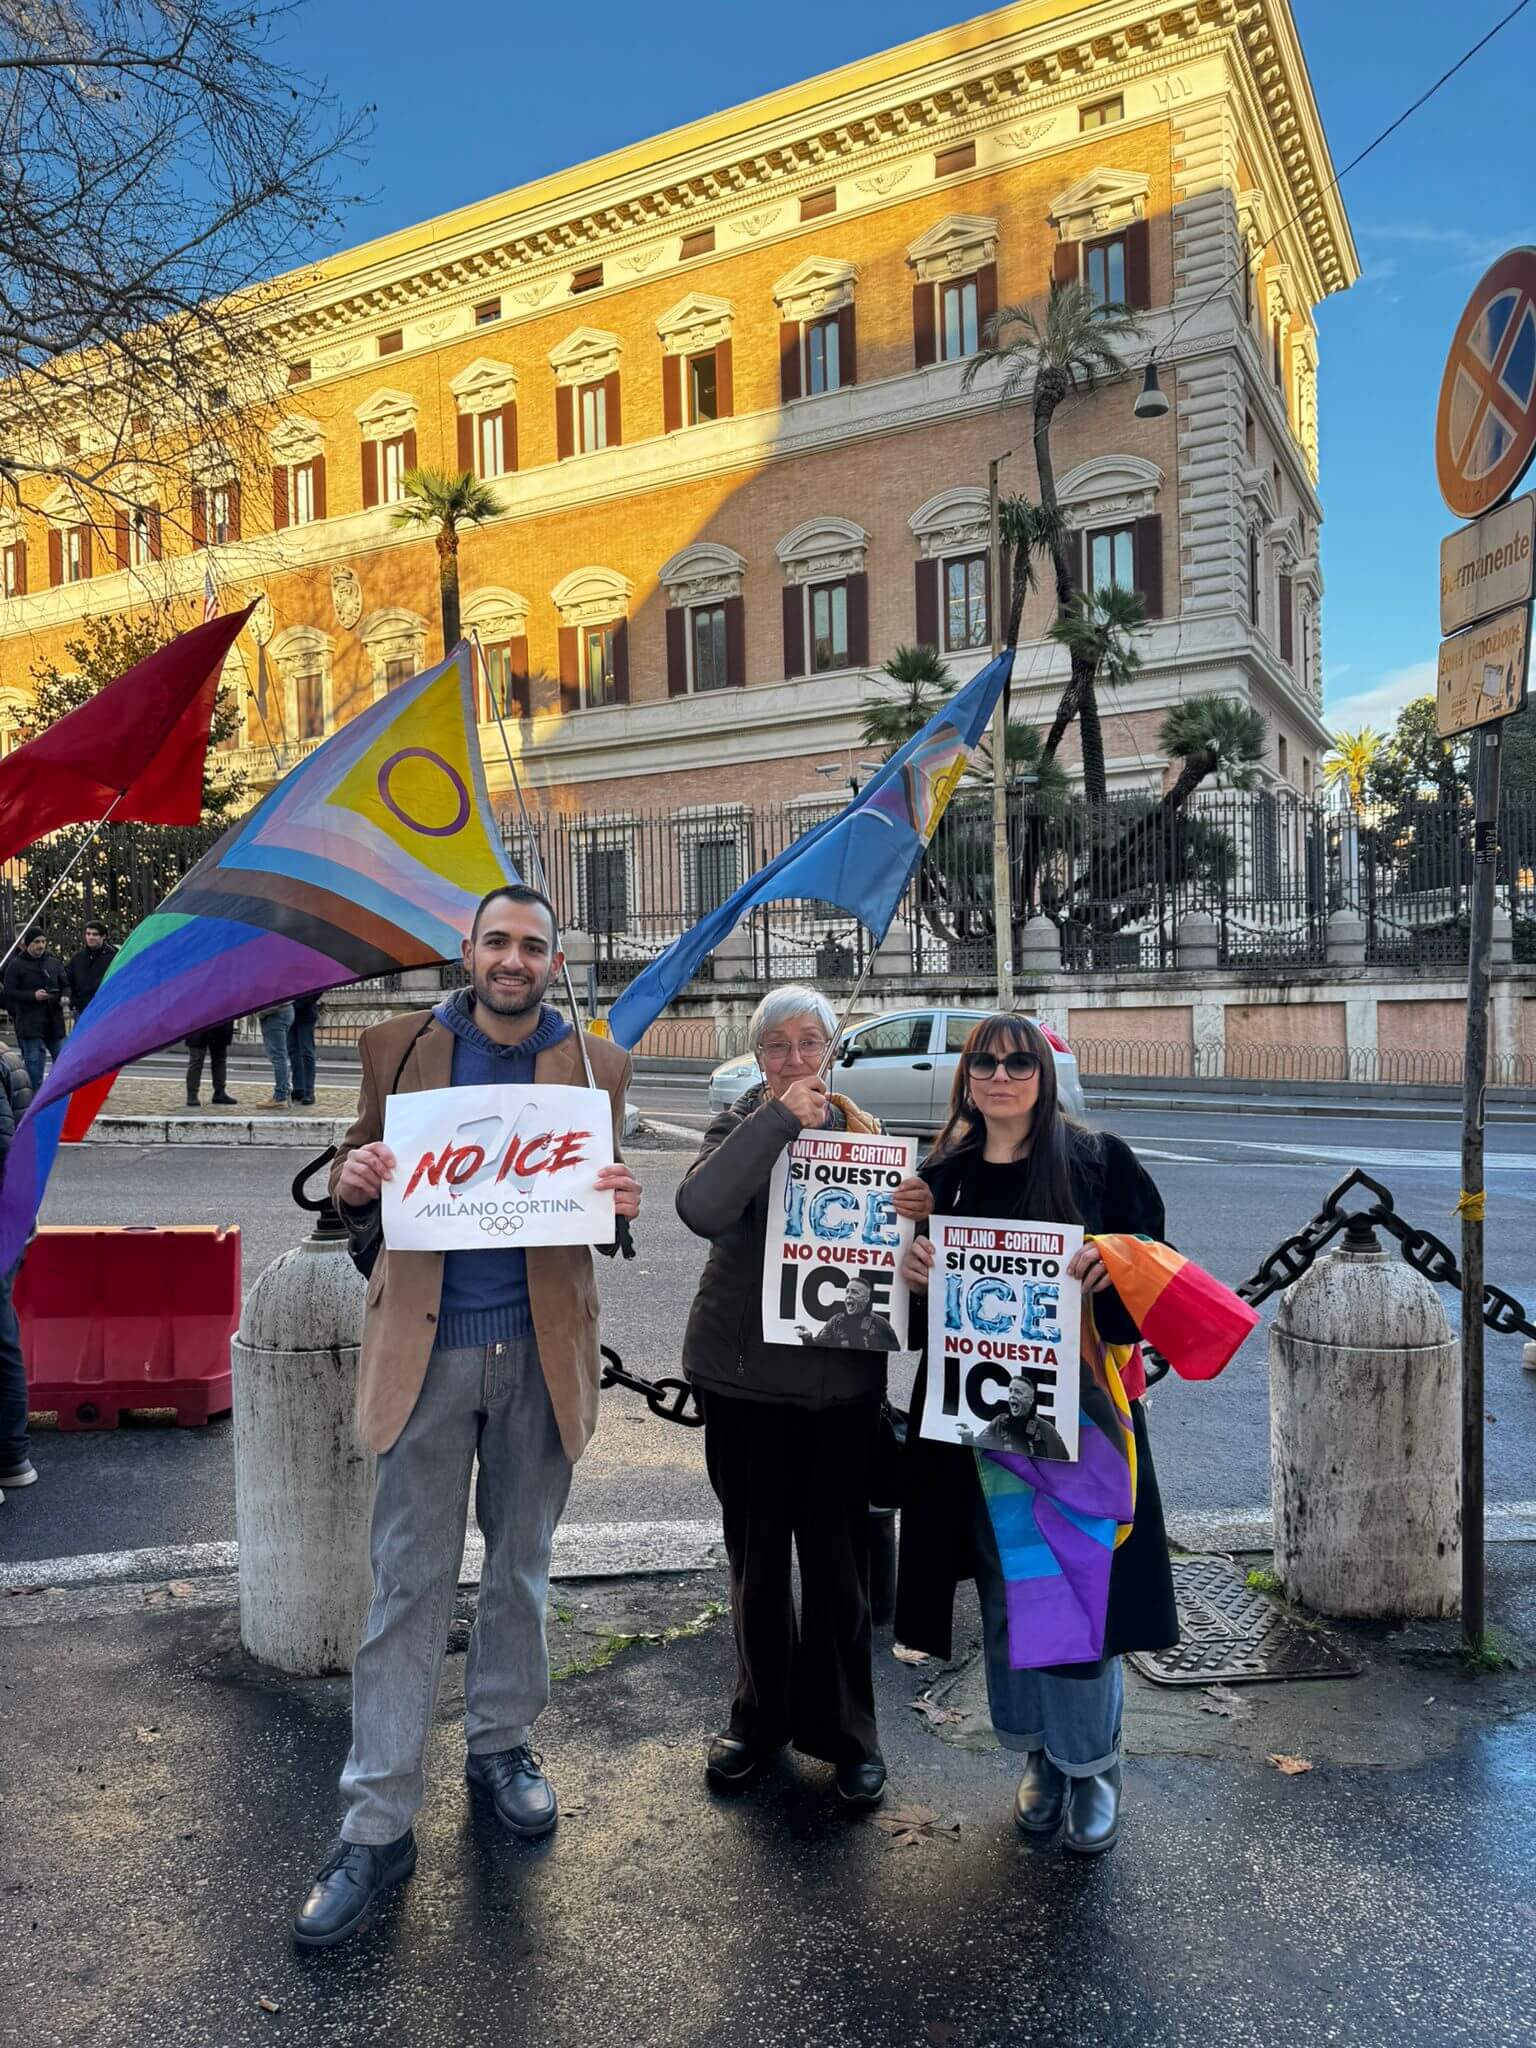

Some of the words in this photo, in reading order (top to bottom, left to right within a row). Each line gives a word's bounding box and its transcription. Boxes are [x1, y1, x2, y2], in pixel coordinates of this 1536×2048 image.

[792, 1141, 841, 1160] MILANO
[402, 1141, 486, 1203] NO
[495, 1129, 595, 1186] ICE
[815, 1165, 902, 1188] QUESTO
[415, 1201, 498, 1218] MILANO
[503, 1199, 584, 1214] CORTINA
[783, 1184, 901, 1247] ICE
[947, 1228, 995, 1248] MILANO
[783, 1243, 812, 1260] NO
[817, 1246, 896, 1267] QUESTA
[969, 1254, 1060, 1278] QUESTO
[779, 1263, 894, 1323] ICE
[944, 1273, 1062, 1344] ICE
[945, 1336, 973, 1354] NO
[977, 1339, 1059, 1365] QUESTA
[942, 1357, 1058, 1427] ICE
